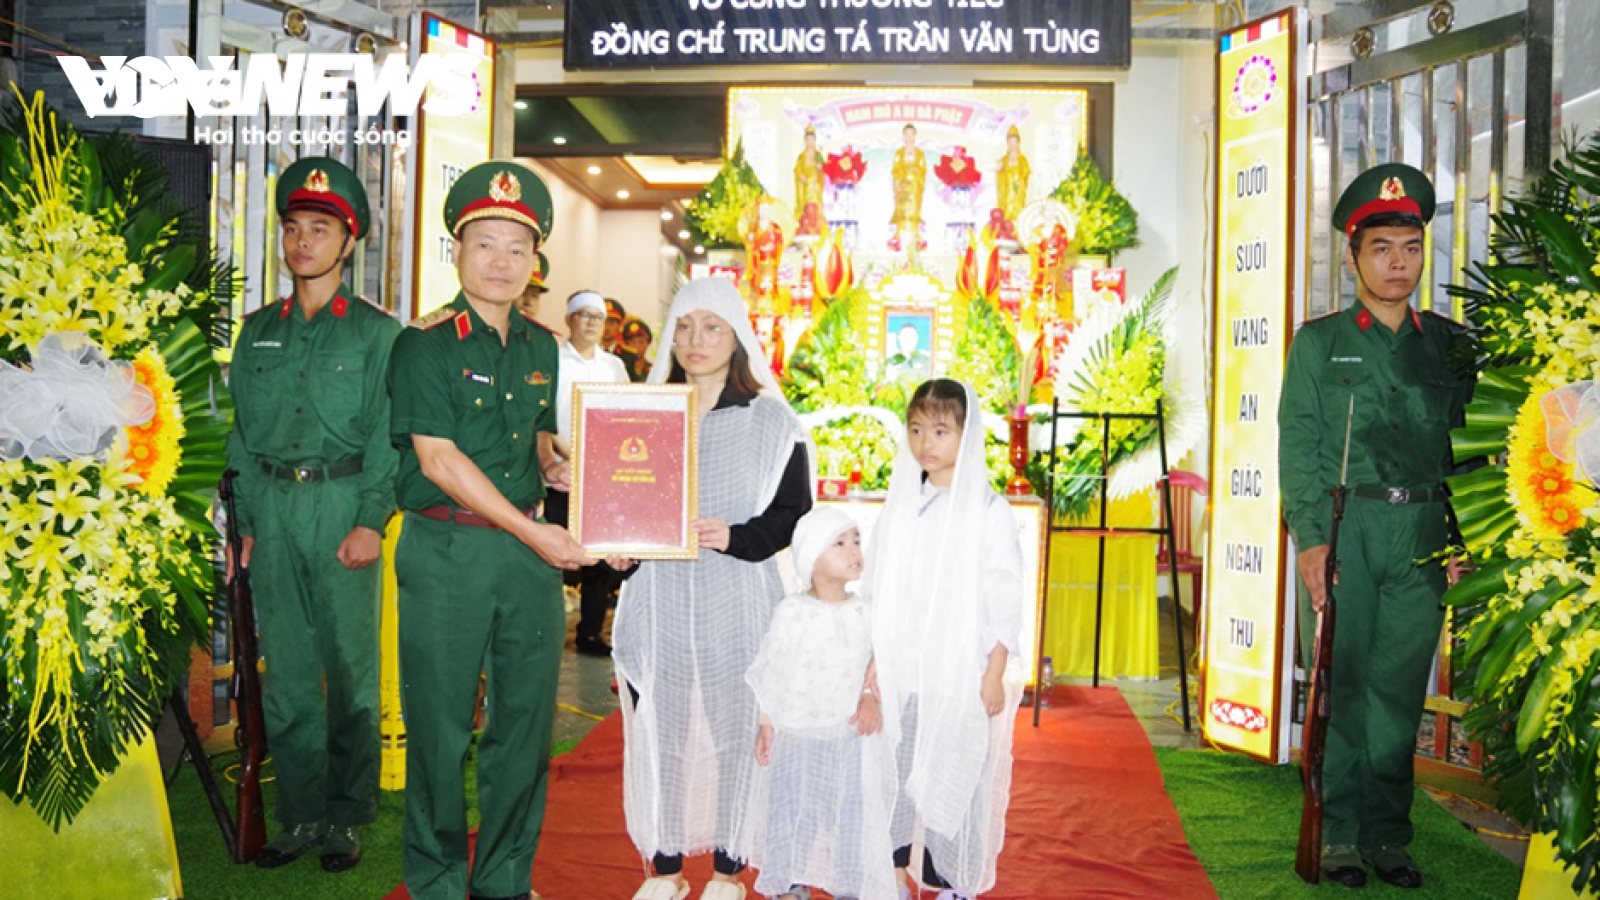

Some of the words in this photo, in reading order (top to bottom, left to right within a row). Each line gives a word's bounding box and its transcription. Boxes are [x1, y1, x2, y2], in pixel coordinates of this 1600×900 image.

[590, 21, 670, 55] ĐỒNG
[677, 20, 725, 54] CHÍ
[733, 27, 826, 54] TRUNG
[834, 19, 872, 53] TÁ
[877, 20, 950, 53] TRẦN
[959, 20, 1013, 53] VĂN
[1022, 19, 1100, 53] TÙNG
[1238, 393, 1258, 421] AN
[1229, 616, 1254, 648] THU
